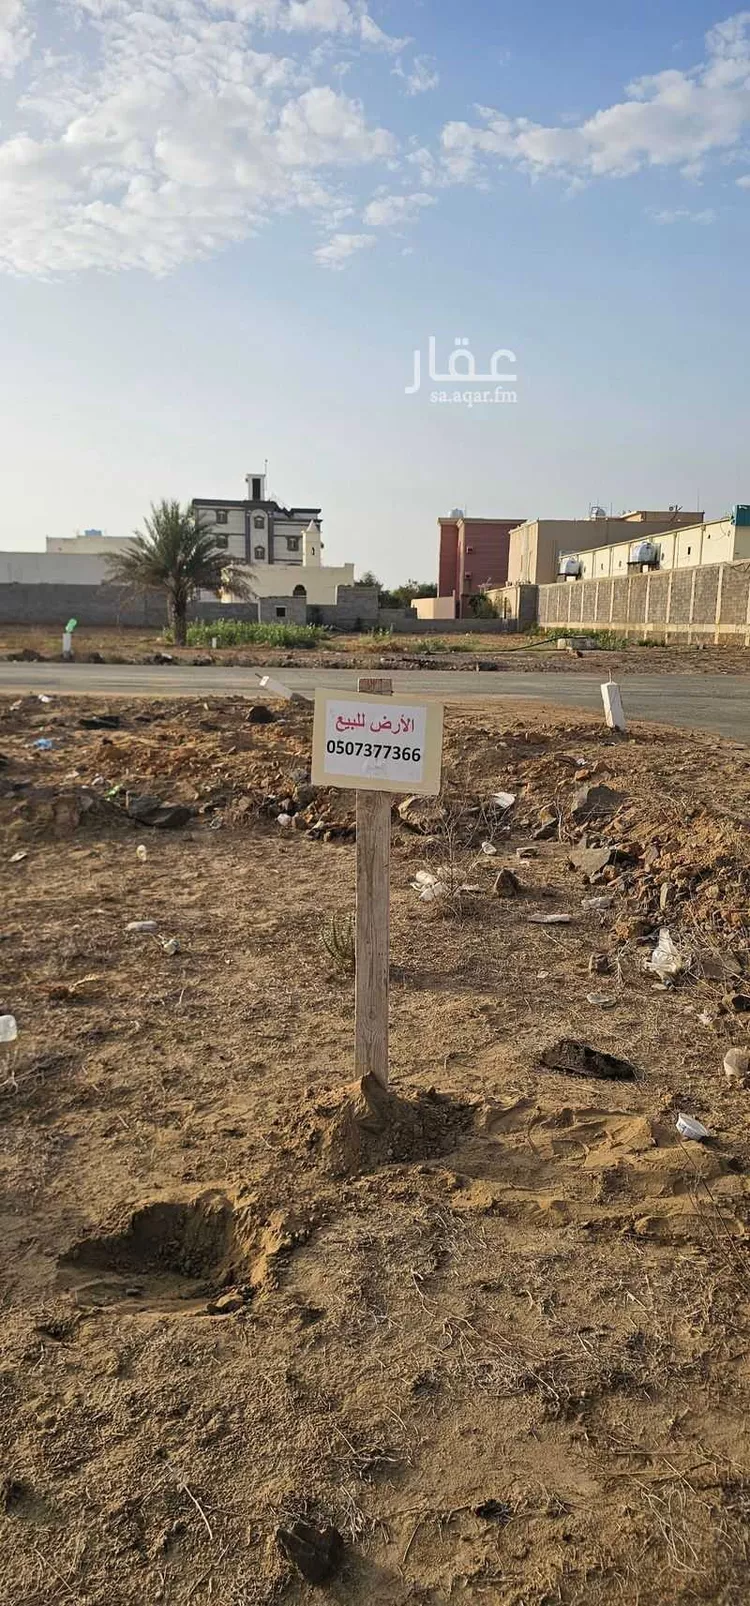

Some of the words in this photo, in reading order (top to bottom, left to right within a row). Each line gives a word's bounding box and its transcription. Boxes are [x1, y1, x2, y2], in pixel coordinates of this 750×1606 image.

[335, 712, 366, 732] للبيع
[369, 714, 415, 735] الأرض
[326, 739, 421, 762] 0507377366
